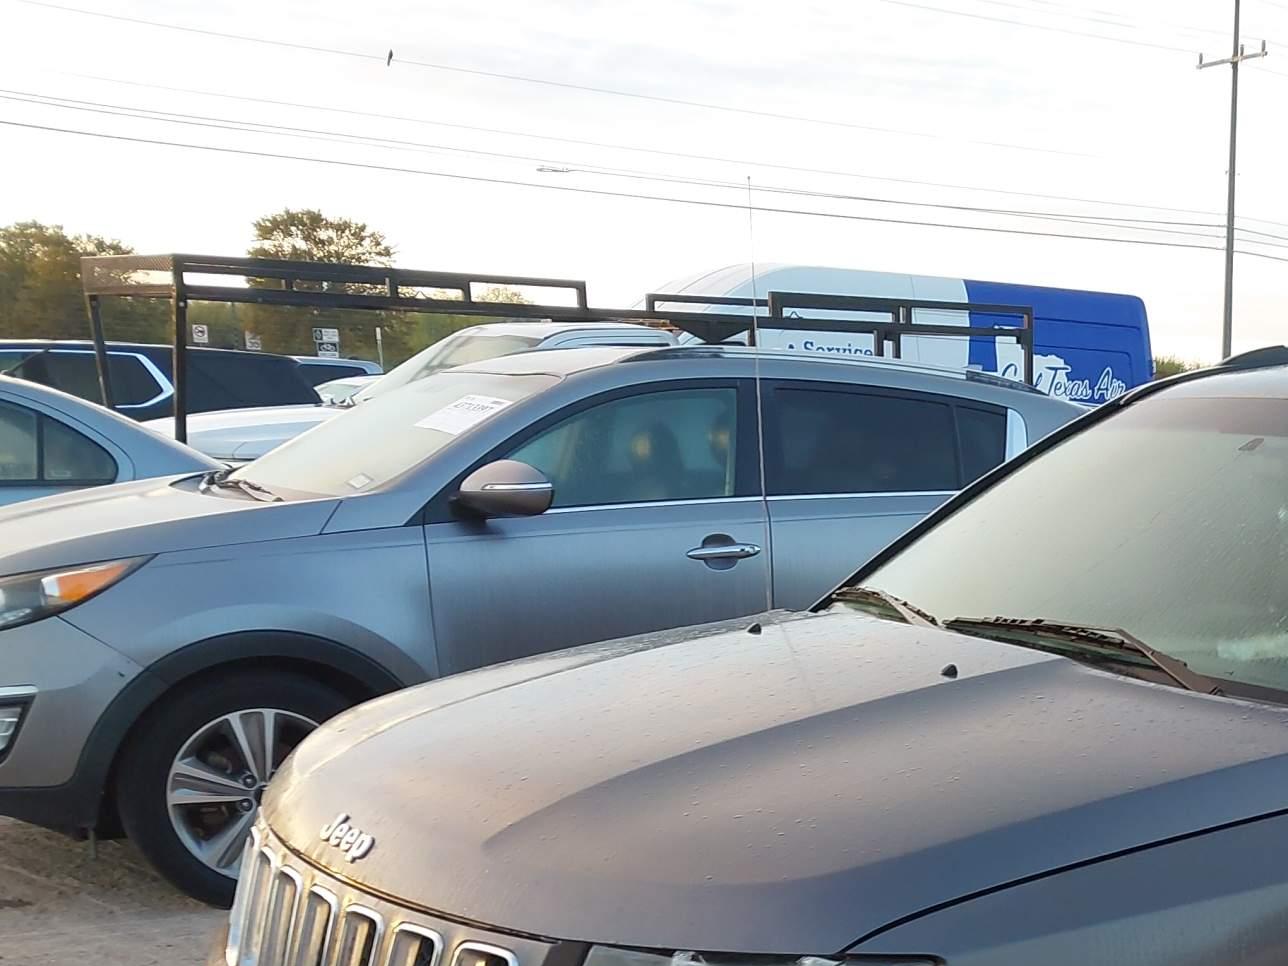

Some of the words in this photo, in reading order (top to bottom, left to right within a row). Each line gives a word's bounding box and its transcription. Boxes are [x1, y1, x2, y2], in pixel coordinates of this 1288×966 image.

[1044, 366, 1091, 399] Texas
[1094, 367, 1125, 399] Air
[320, 812, 375, 863] Jeep
